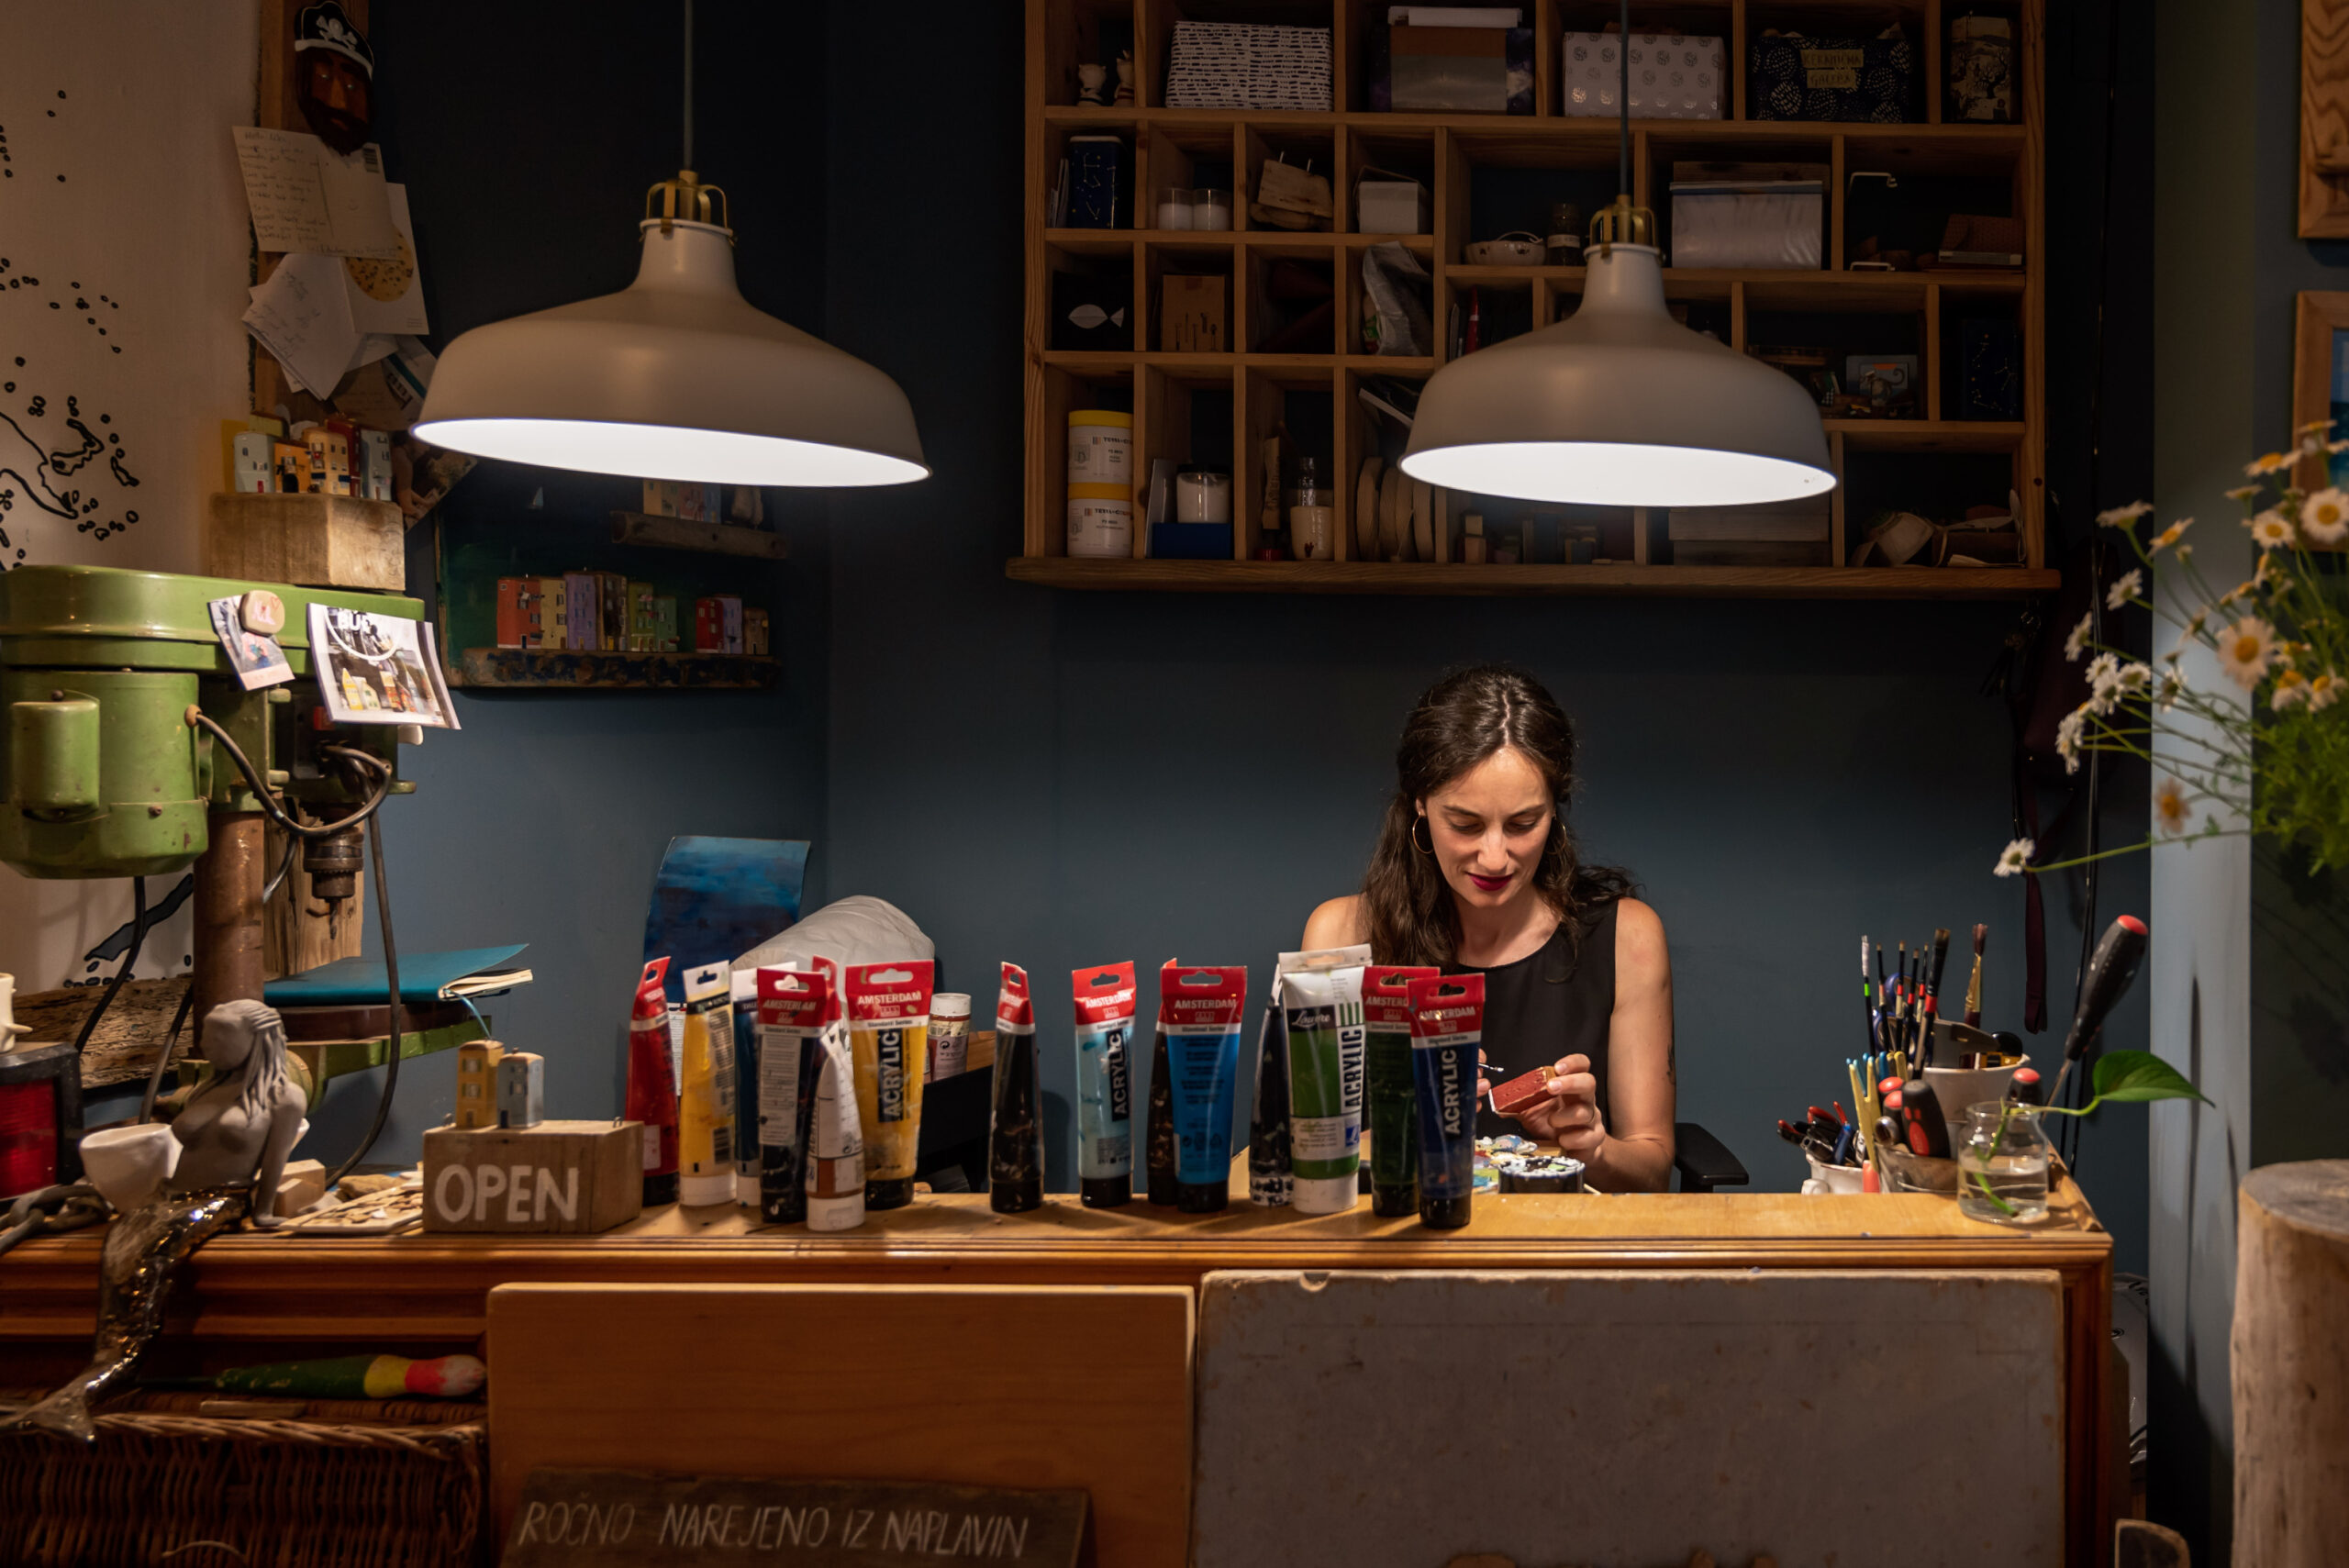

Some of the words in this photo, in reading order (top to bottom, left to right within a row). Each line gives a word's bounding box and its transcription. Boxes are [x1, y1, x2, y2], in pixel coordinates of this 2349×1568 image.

[858, 992, 921, 1005] AMSTERDAM
[1085, 992, 1132, 1009] AMSTERDAM
[1174, 999, 1236, 1009] AMSTERDAM
[882, 1030, 900, 1117] ACRYLIC
[1109, 1033, 1127, 1116] ACRYLIC
[1341, 1029, 1363, 1108] ACRYLIC
[1442, 1049, 1461, 1136] ACRYLIC
[434, 1163, 579, 1223] OPEN
[518, 1491, 635, 1546] ROČNO
[658, 1502, 829, 1550] NAREJENO
[841, 1508, 874, 1549] IZ
[881, 1510, 1029, 1559] NAPLAVIN
